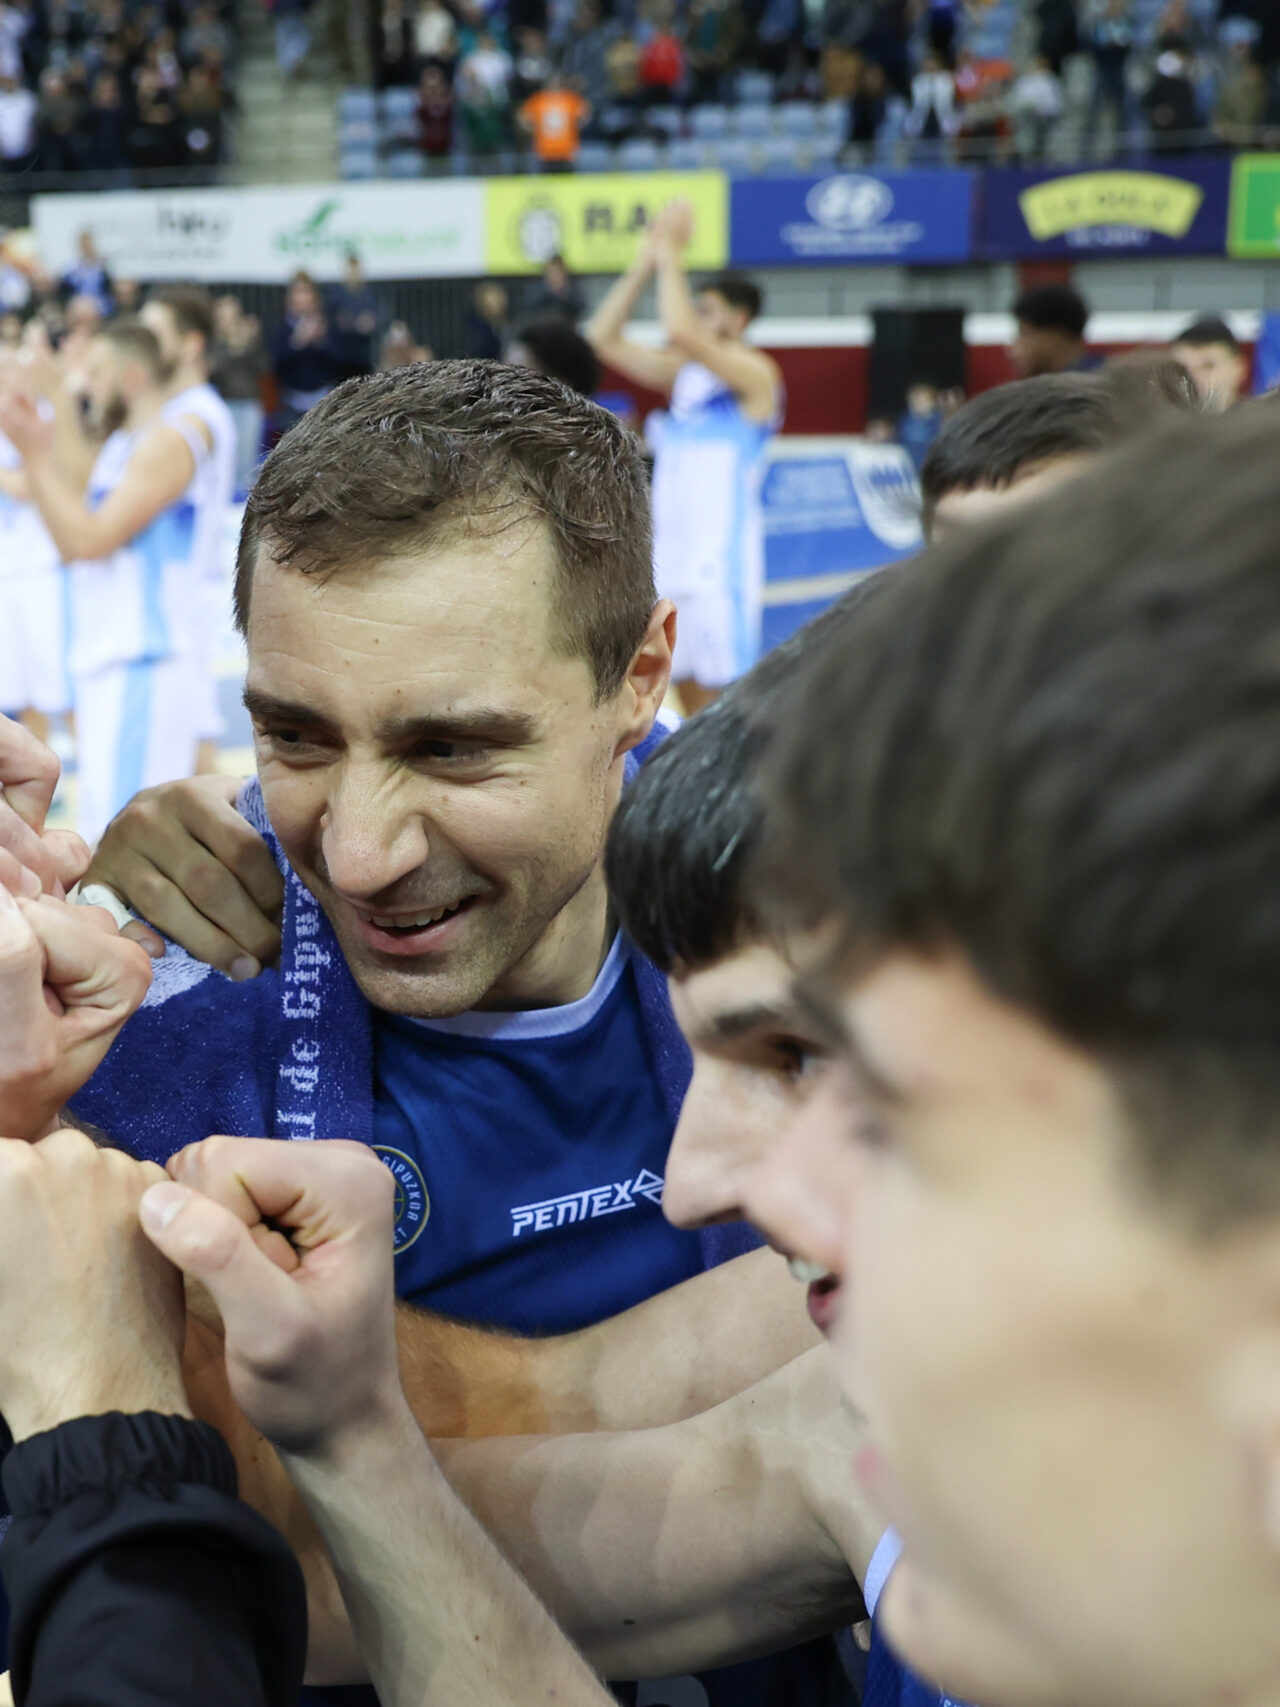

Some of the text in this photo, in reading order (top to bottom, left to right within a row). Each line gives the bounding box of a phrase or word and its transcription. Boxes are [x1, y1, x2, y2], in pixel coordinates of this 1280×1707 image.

[278, 1037, 320, 1093] de
[382, 1155, 422, 1222] GIPUZKOA
[511, 1179, 636, 1237] PENTEX
